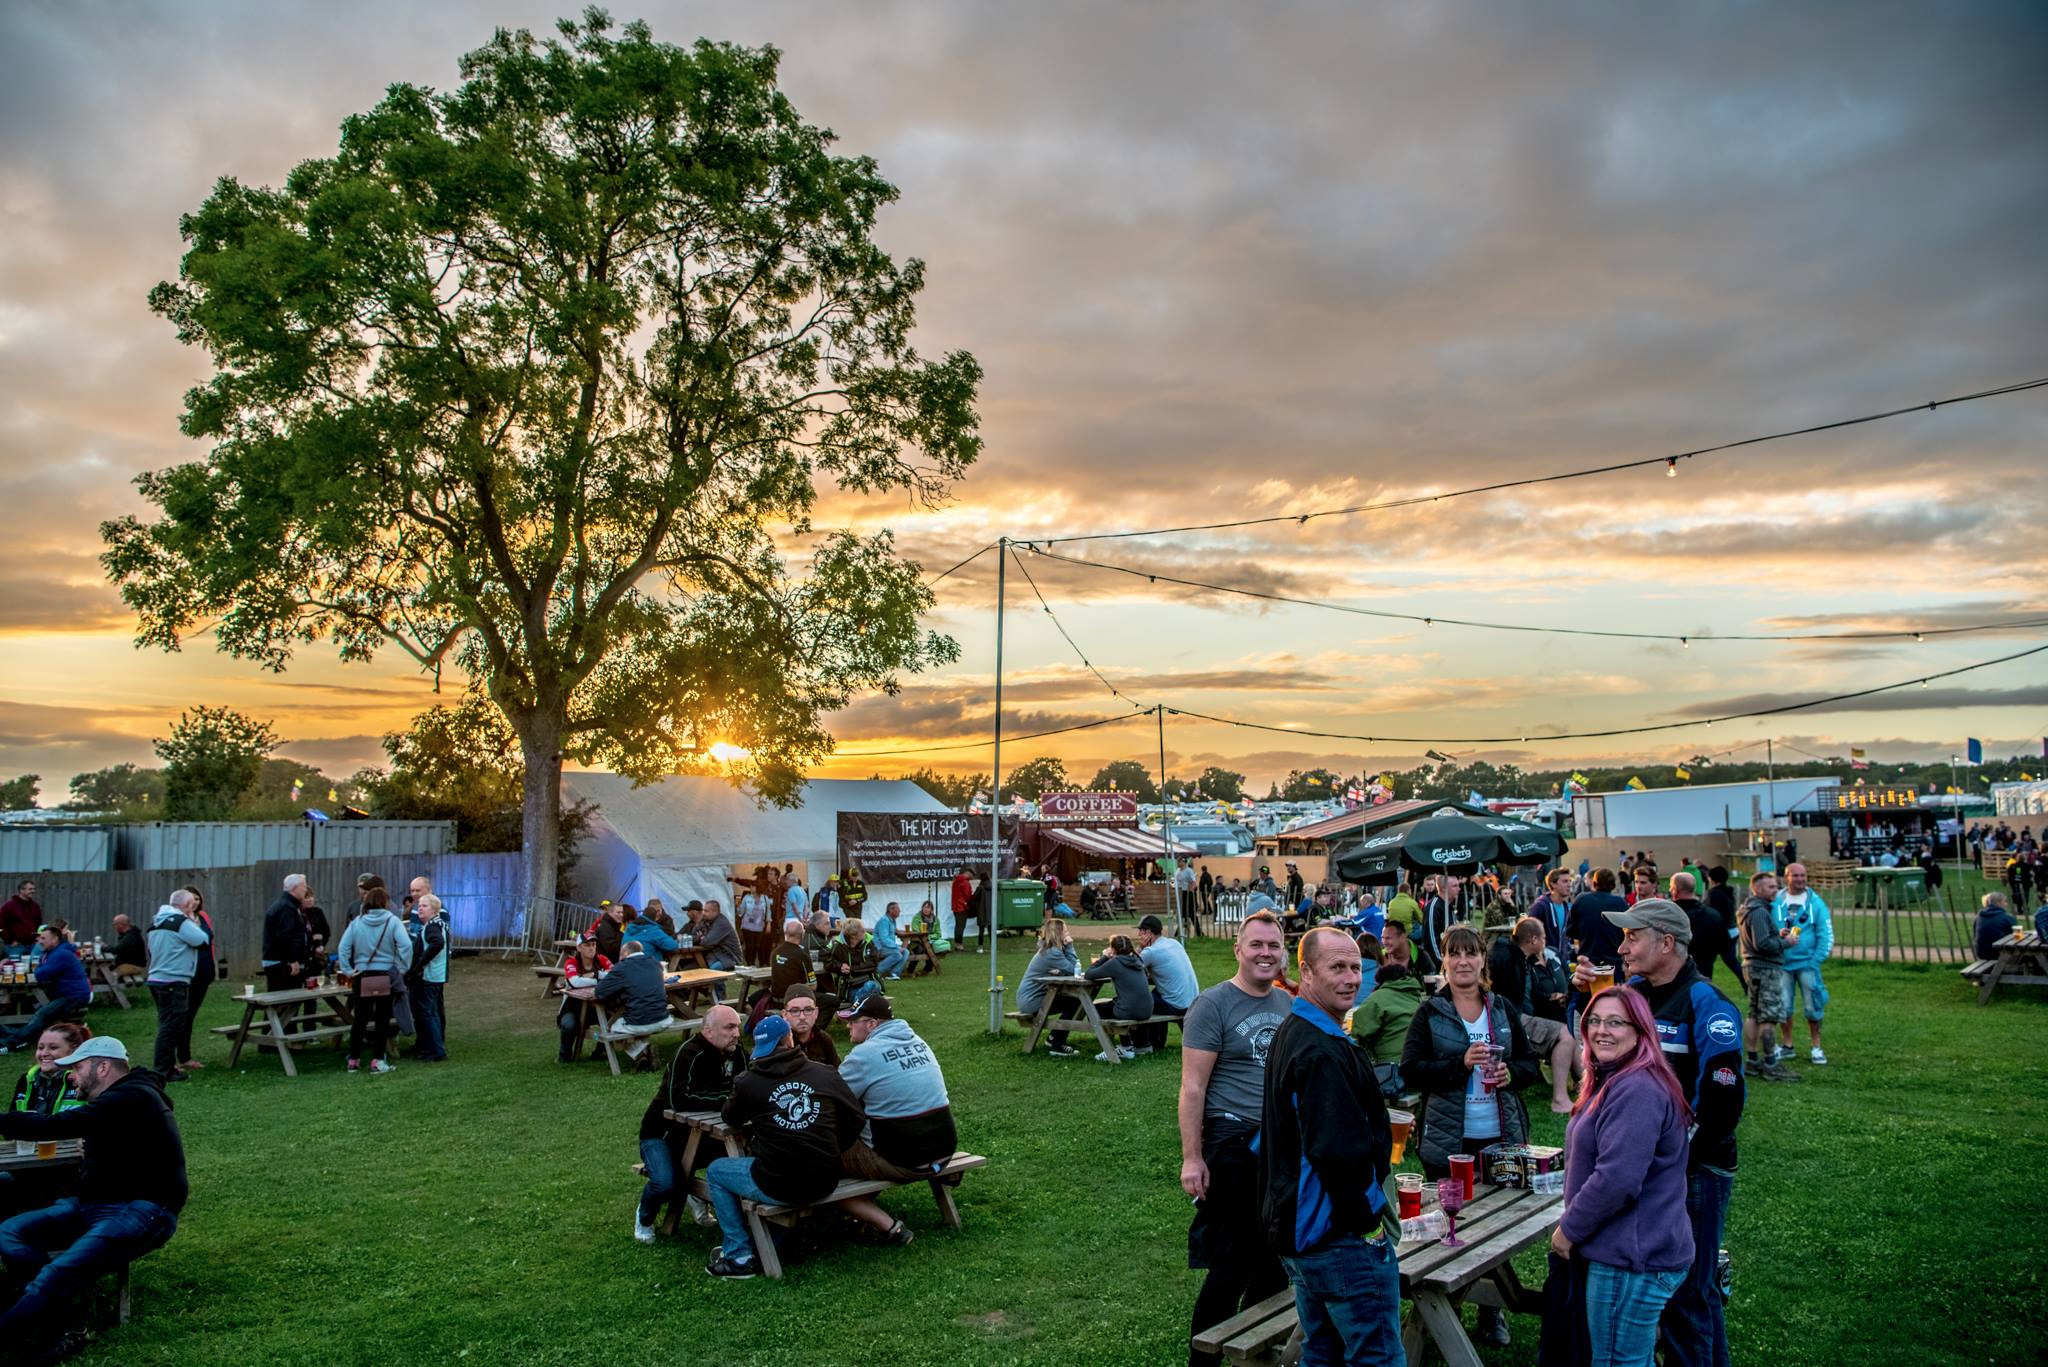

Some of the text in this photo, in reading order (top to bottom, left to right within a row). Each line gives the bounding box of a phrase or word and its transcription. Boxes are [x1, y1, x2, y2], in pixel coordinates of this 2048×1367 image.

[1056, 798, 1123, 811] COFFEE
[900, 819, 968, 836] THE PIT SHOP
[1431, 846, 1472, 864] Carlsberg
[906, 868, 923, 879] OPEN
[924, 868, 940, 879] EARLY
[1375, 862, 1384, 871] 47
[882, 1042, 928, 1063] ISLE OF
[899, 1054, 931, 1071] MAN
[1712, 1070, 1737, 1084] URBAN
[768, 1082, 815, 1102] TAISSOTIN
[773, 1101, 821, 1130] MOTARD CLUB
